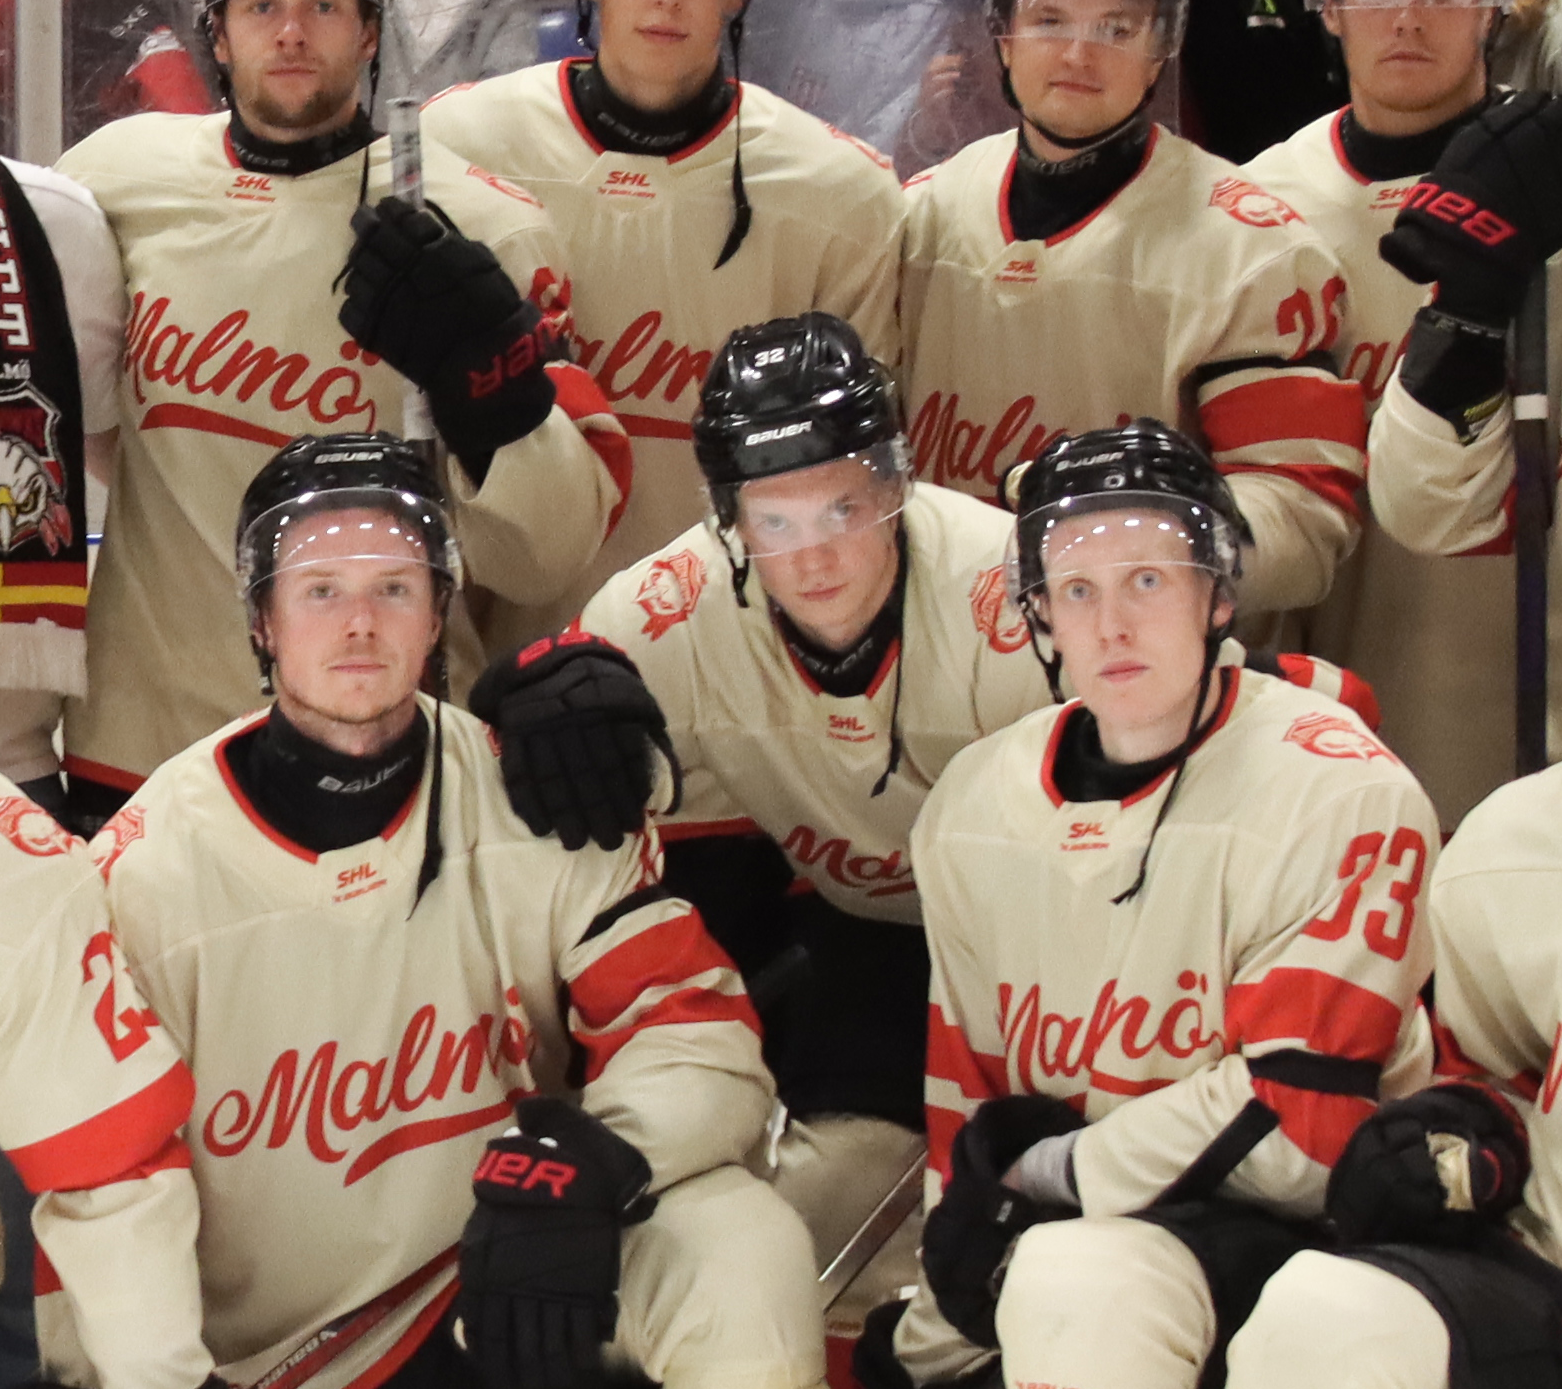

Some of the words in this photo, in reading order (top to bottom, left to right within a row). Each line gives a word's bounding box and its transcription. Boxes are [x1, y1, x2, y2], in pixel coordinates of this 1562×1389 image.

[232, 174, 273, 191] SHL
[605, 170, 652, 188] SHL
[1376, 186, 1411, 201] SH
[1404, 182, 1517, 247] BAU
[122, 290, 379, 434] Malmö
[754, 346, 786, 366] 32
[744, 420, 814, 447] BAUER
[314, 451, 385, 469] BAUER
[828, 714, 866, 731] SHL
[1067, 822, 1106, 839] SHL
[336, 862, 378, 889] SHL
[1301, 826, 1429, 963] 33
[471, 1146, 579, 1200] UER
